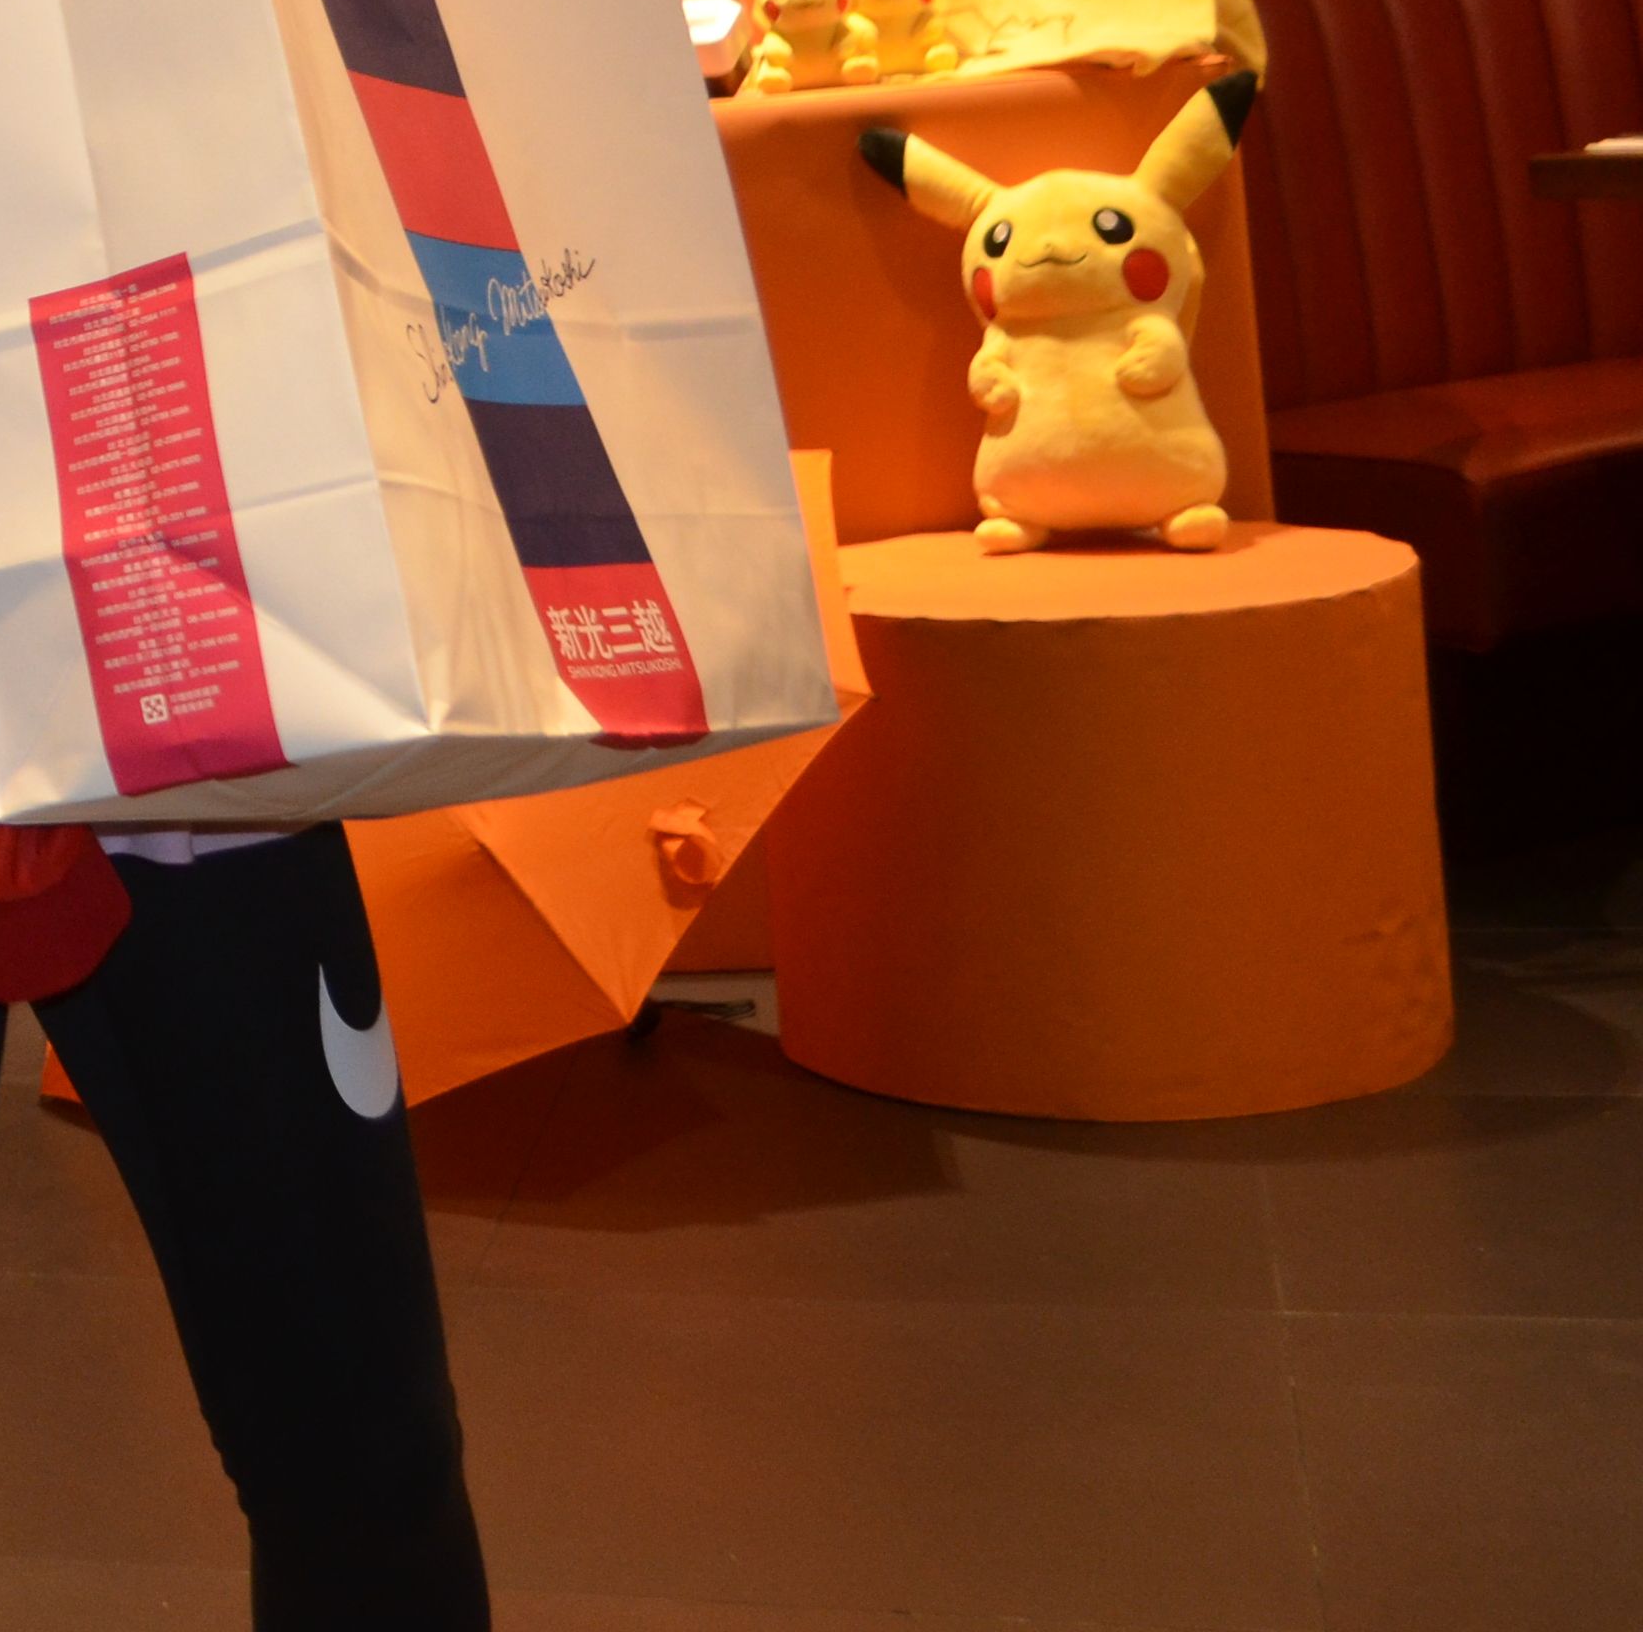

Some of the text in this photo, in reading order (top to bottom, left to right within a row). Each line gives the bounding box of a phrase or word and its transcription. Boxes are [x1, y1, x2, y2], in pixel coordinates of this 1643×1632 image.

[546, 599, 676, 660] 新光三越
[615, 656, 684, 676] MITSUKOSHI
